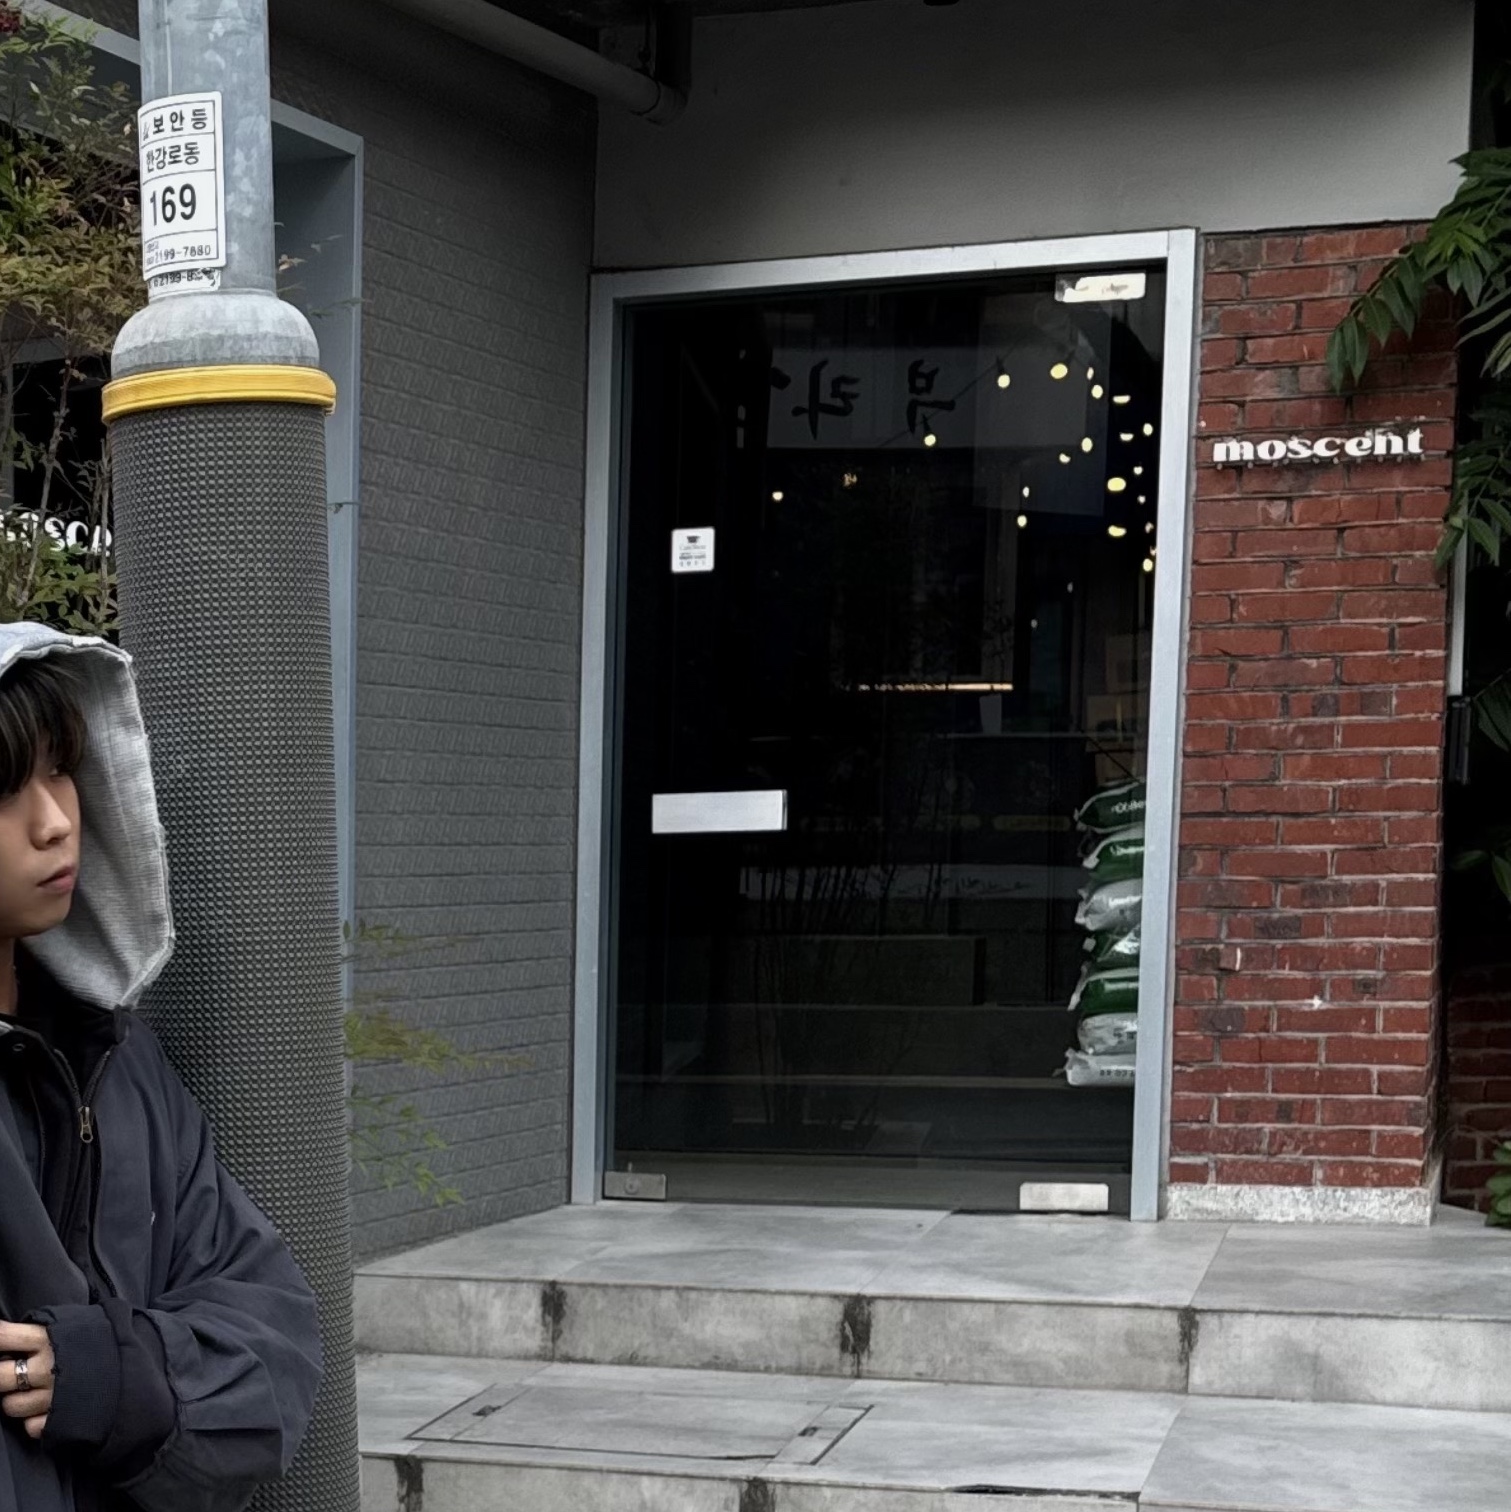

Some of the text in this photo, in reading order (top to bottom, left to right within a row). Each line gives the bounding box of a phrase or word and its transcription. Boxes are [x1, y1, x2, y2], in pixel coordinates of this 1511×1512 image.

[153, 108, 208, 135] 보안등
[146, 142, 200, 173] 한강로동
[149, 183, 197, 226] 169
[1213, 428, 1423, 462] moscent
